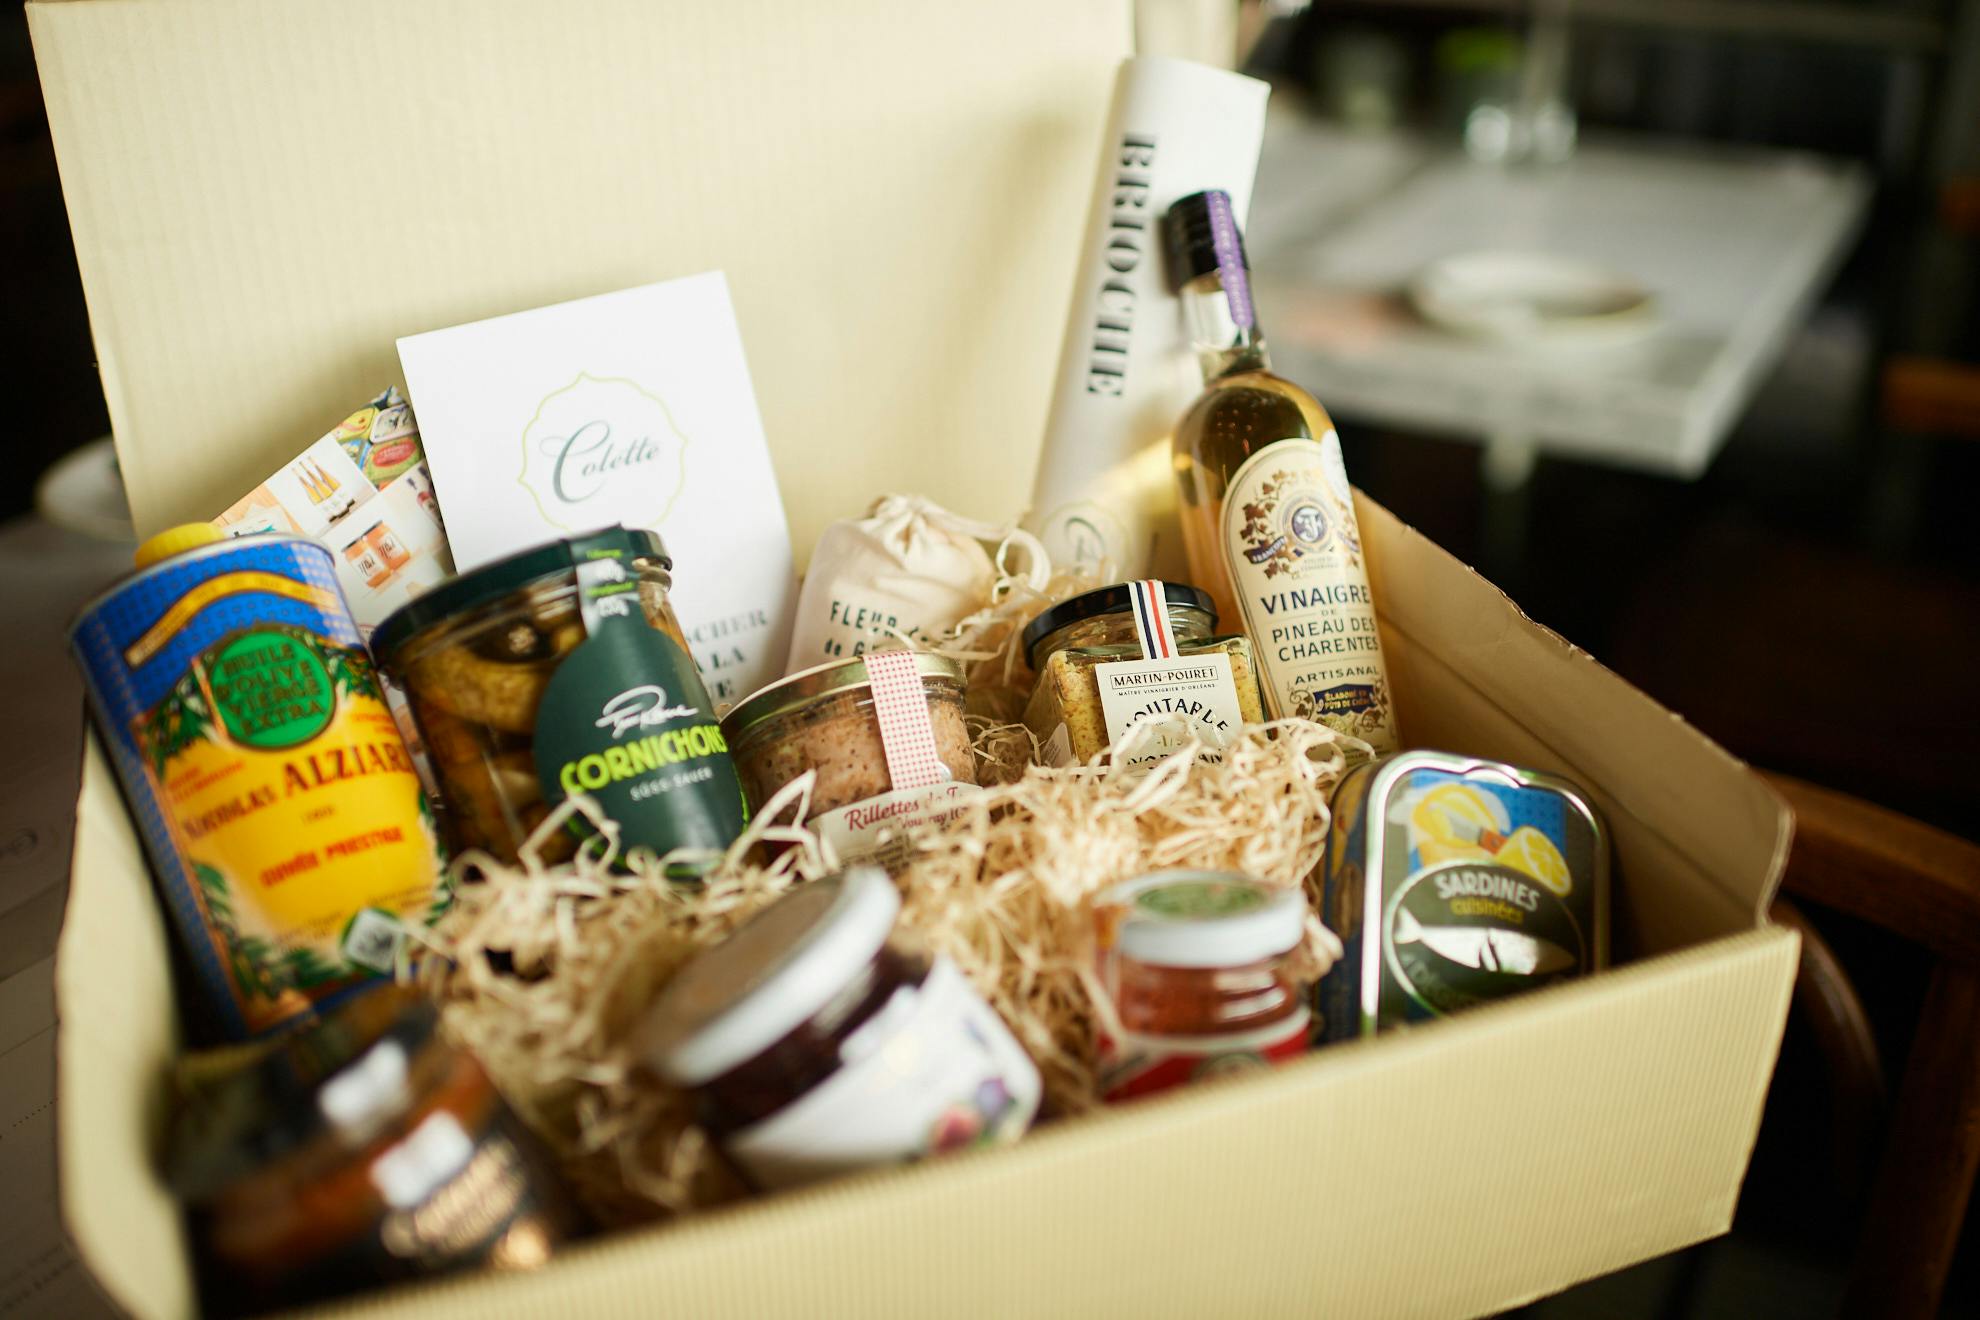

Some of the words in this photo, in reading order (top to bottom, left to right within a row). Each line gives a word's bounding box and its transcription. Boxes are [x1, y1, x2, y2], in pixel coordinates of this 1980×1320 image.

[1087, 135, 1156, 397] BRIOCHE
[539, 420, 660, 503] Colette
[1260, 585, 1371, 615] VINAIGRE
[1272, 618, 1345, 644] PINEAU
[1350, 616, 1376, 632] DES
[1278, 635, 1379, 662] CHARENTES
[1113, 668, 1214, 687] MARTIN-POURET
[1294, 666, 1381, 686] ARTISANAL
[560, 725, 728, 793] CORNICHONS
[844, 799, 920, 832] Rillettes
[1434, 870, 1540, 912] SARDINES
